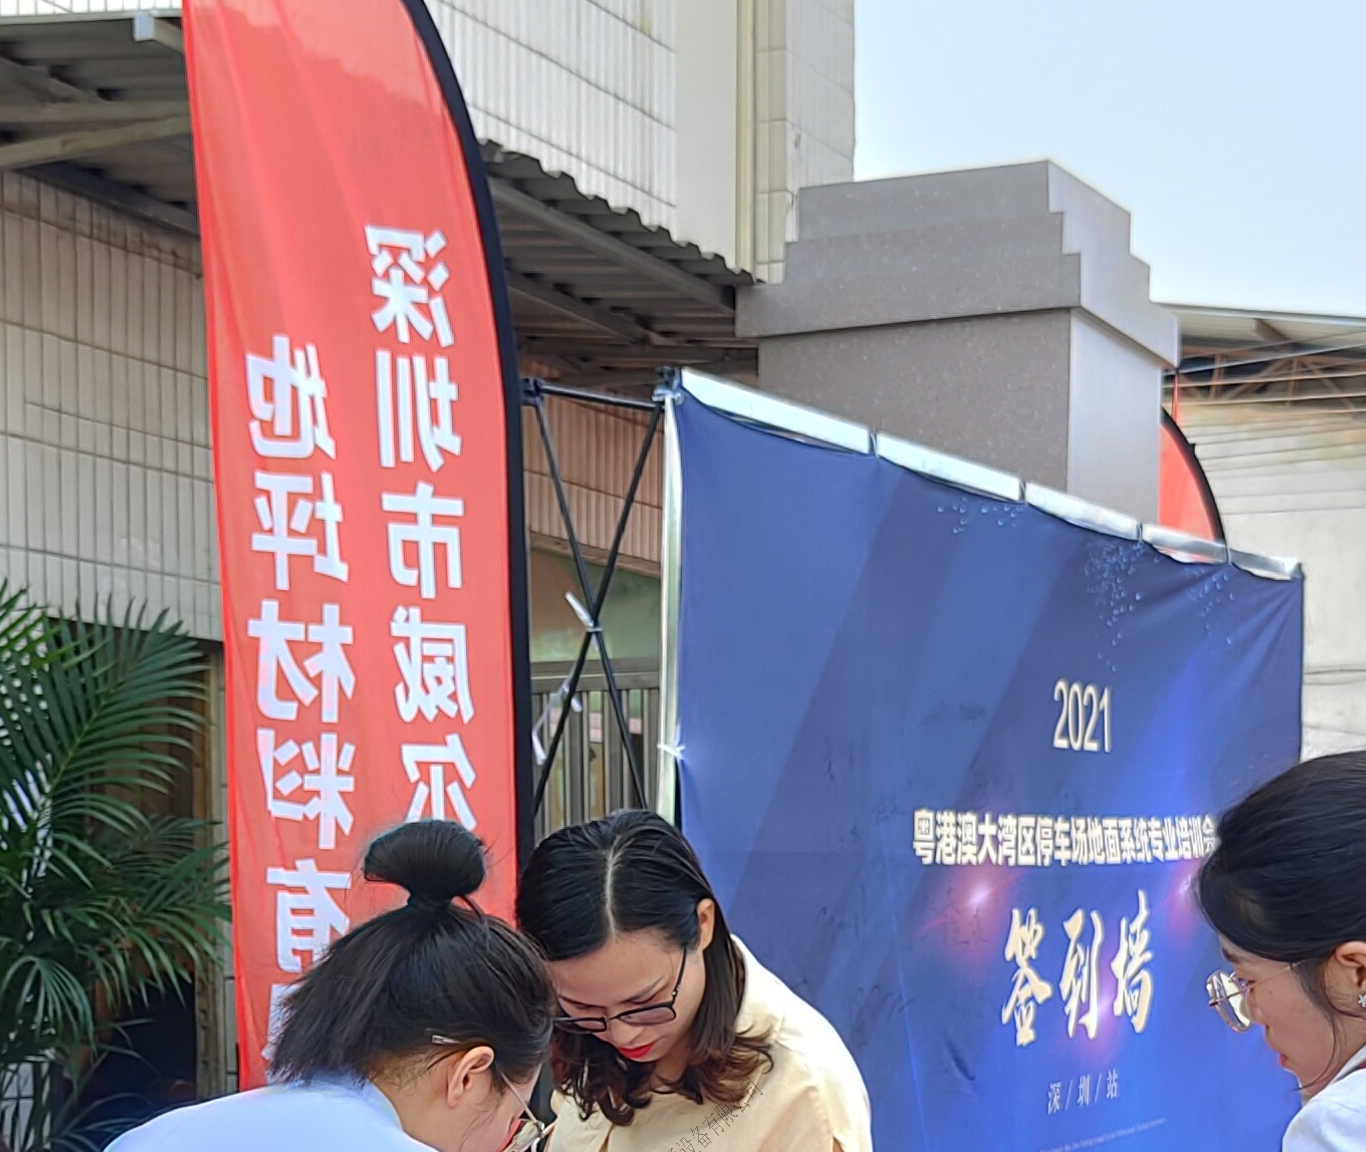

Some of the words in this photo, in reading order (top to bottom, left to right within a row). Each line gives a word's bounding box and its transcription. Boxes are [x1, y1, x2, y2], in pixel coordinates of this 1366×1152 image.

[1052, 677, 1113, 753] 2021
[912, 808, 1220, 867] 粤港澳大湾区停车场地面系统专业培训会
[1001, 888, 1153, 1046] 签到墙
